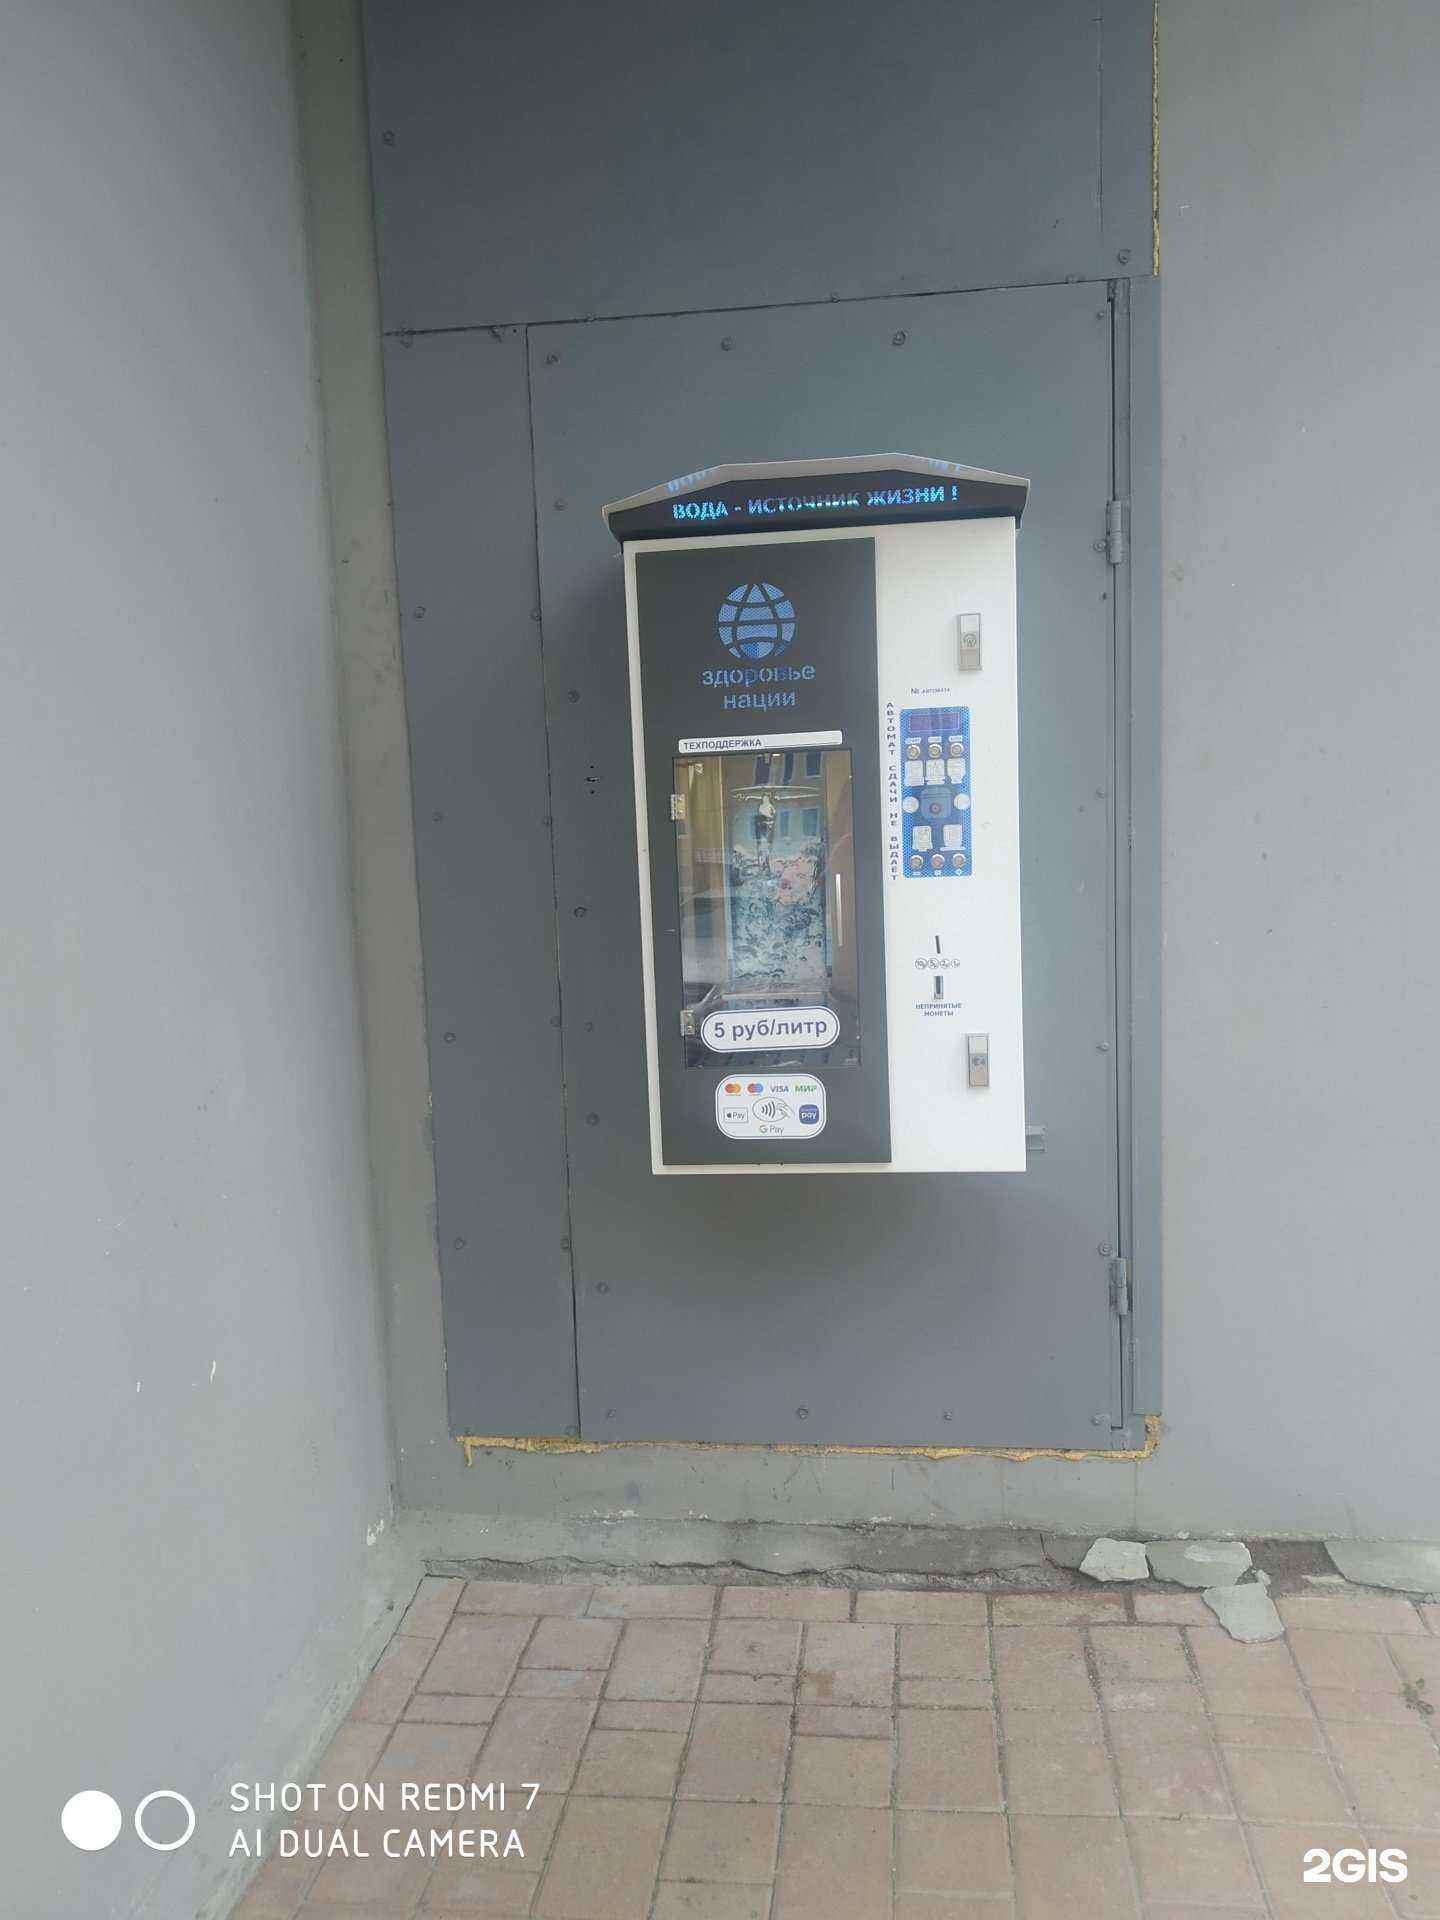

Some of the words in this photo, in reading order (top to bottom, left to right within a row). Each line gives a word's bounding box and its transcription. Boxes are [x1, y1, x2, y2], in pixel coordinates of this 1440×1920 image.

[672, 501, 728, 520] ВОДА
[748, 492, 860, 515] ИСТОЧНИК
[867, 486, 945, 506] ЖИЗНИ
[702, 665, 816, 687] здоровье
[723, 692, 796, 711] нации
[886, 702, 896, 755] АВТОМАТ
[684, 738, 762, 750] ТЕХПОДДЕРЖКА
[888, 765, 898, 803] СДАЧИ
[890, 813, 898, 826] НЕ
[889, 837, 899, 880] ВЫДАЕТ
[714, 1022, 725, 1038] 5
[732, 1019, 827, 1041] руб/литр
[795, 1084, 817, 1092] МИР
[732, 1111, 745, 1120] Pay
[801, 1112, 817, 1120] pay
[770, 1125, 784, 1134] Pay
